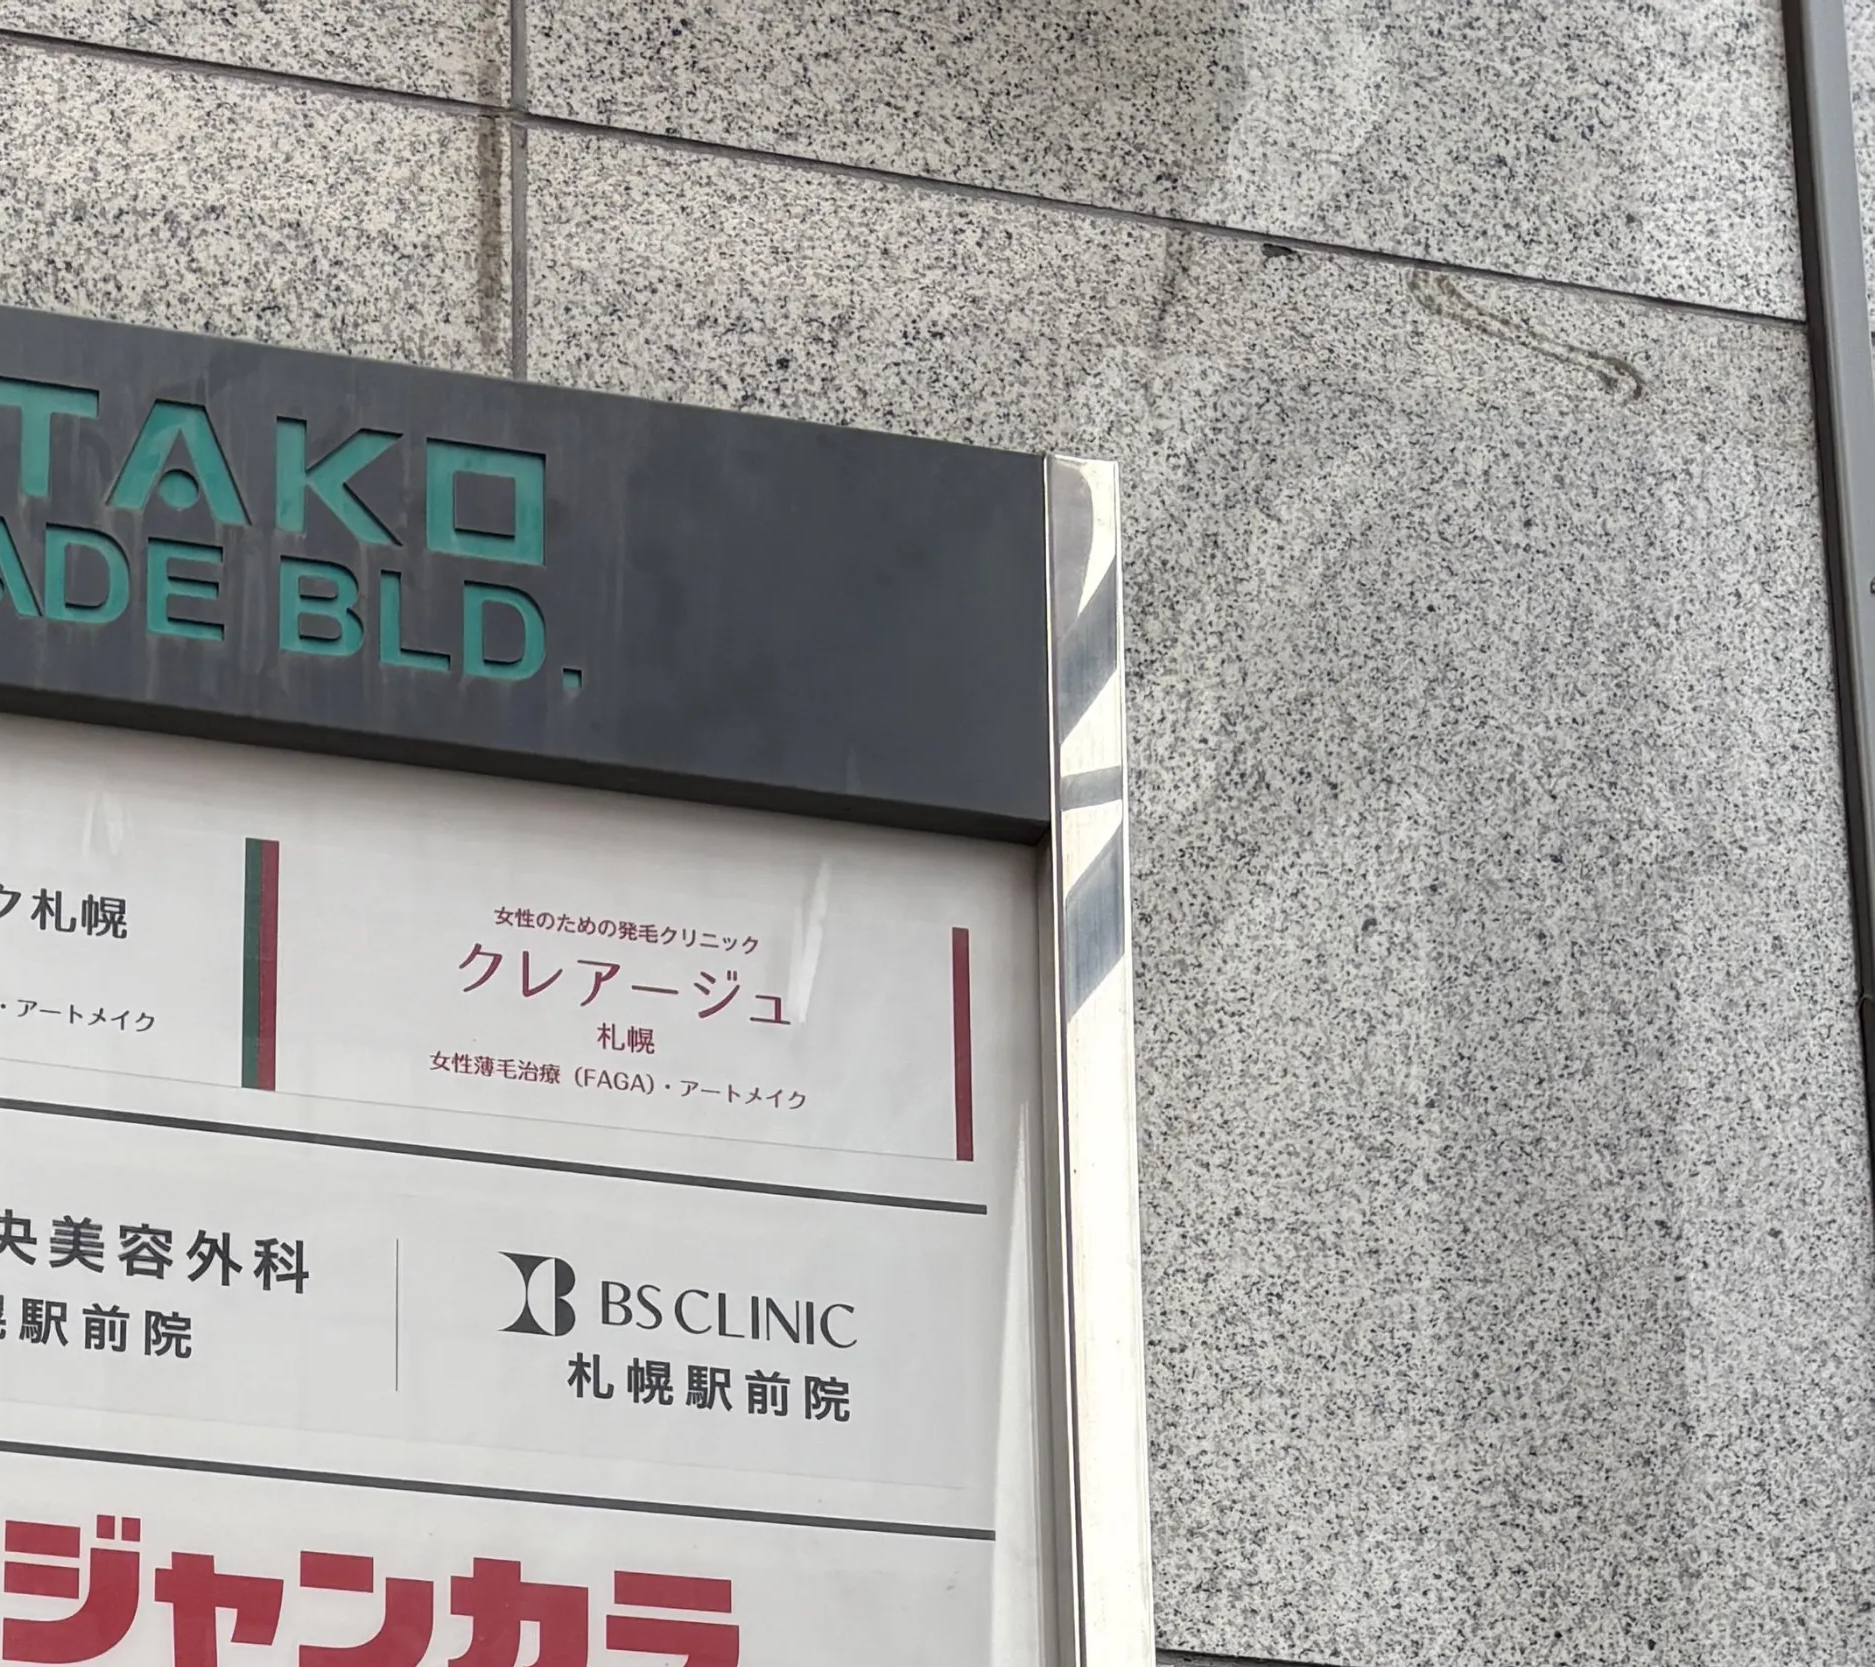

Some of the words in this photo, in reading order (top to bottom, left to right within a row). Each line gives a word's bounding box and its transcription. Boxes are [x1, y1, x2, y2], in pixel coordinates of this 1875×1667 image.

[280, 558, 583, 695] BLD.
[493, 905, 760, 956] 女性のための発毛クリニック
[458, 942, 792, 1026] クレアージュ
[596, 1023, 656, 1056] 札幌
[567, 1352, 851, 1422] 札幌駅前院
